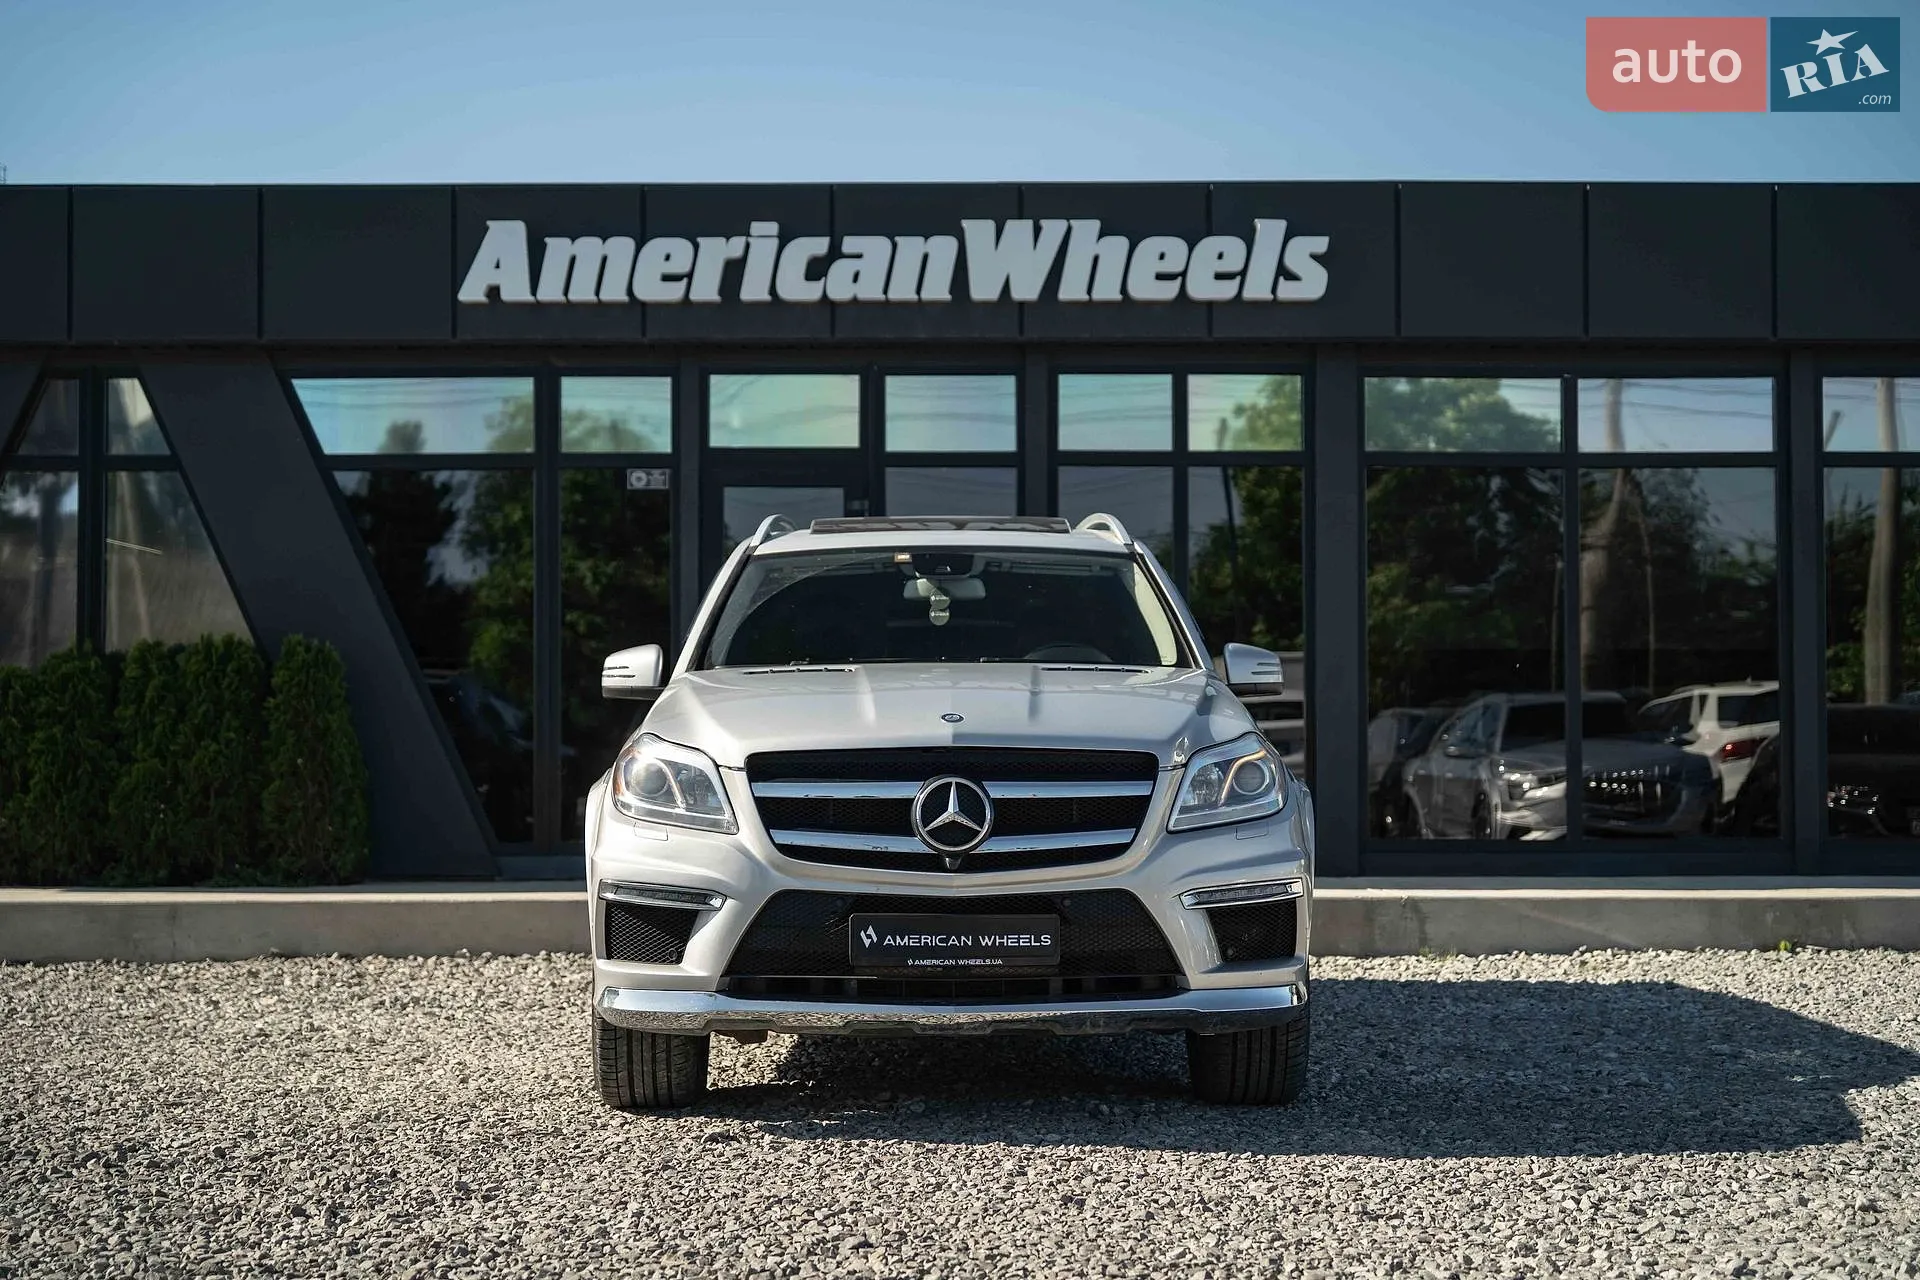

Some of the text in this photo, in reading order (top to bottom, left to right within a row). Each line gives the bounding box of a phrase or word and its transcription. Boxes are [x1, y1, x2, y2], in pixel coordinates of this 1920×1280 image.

[883, 934, 1051, 946] AMERICAN WHEELS
[957, 958, 1003, 966] WHEELS.UA
